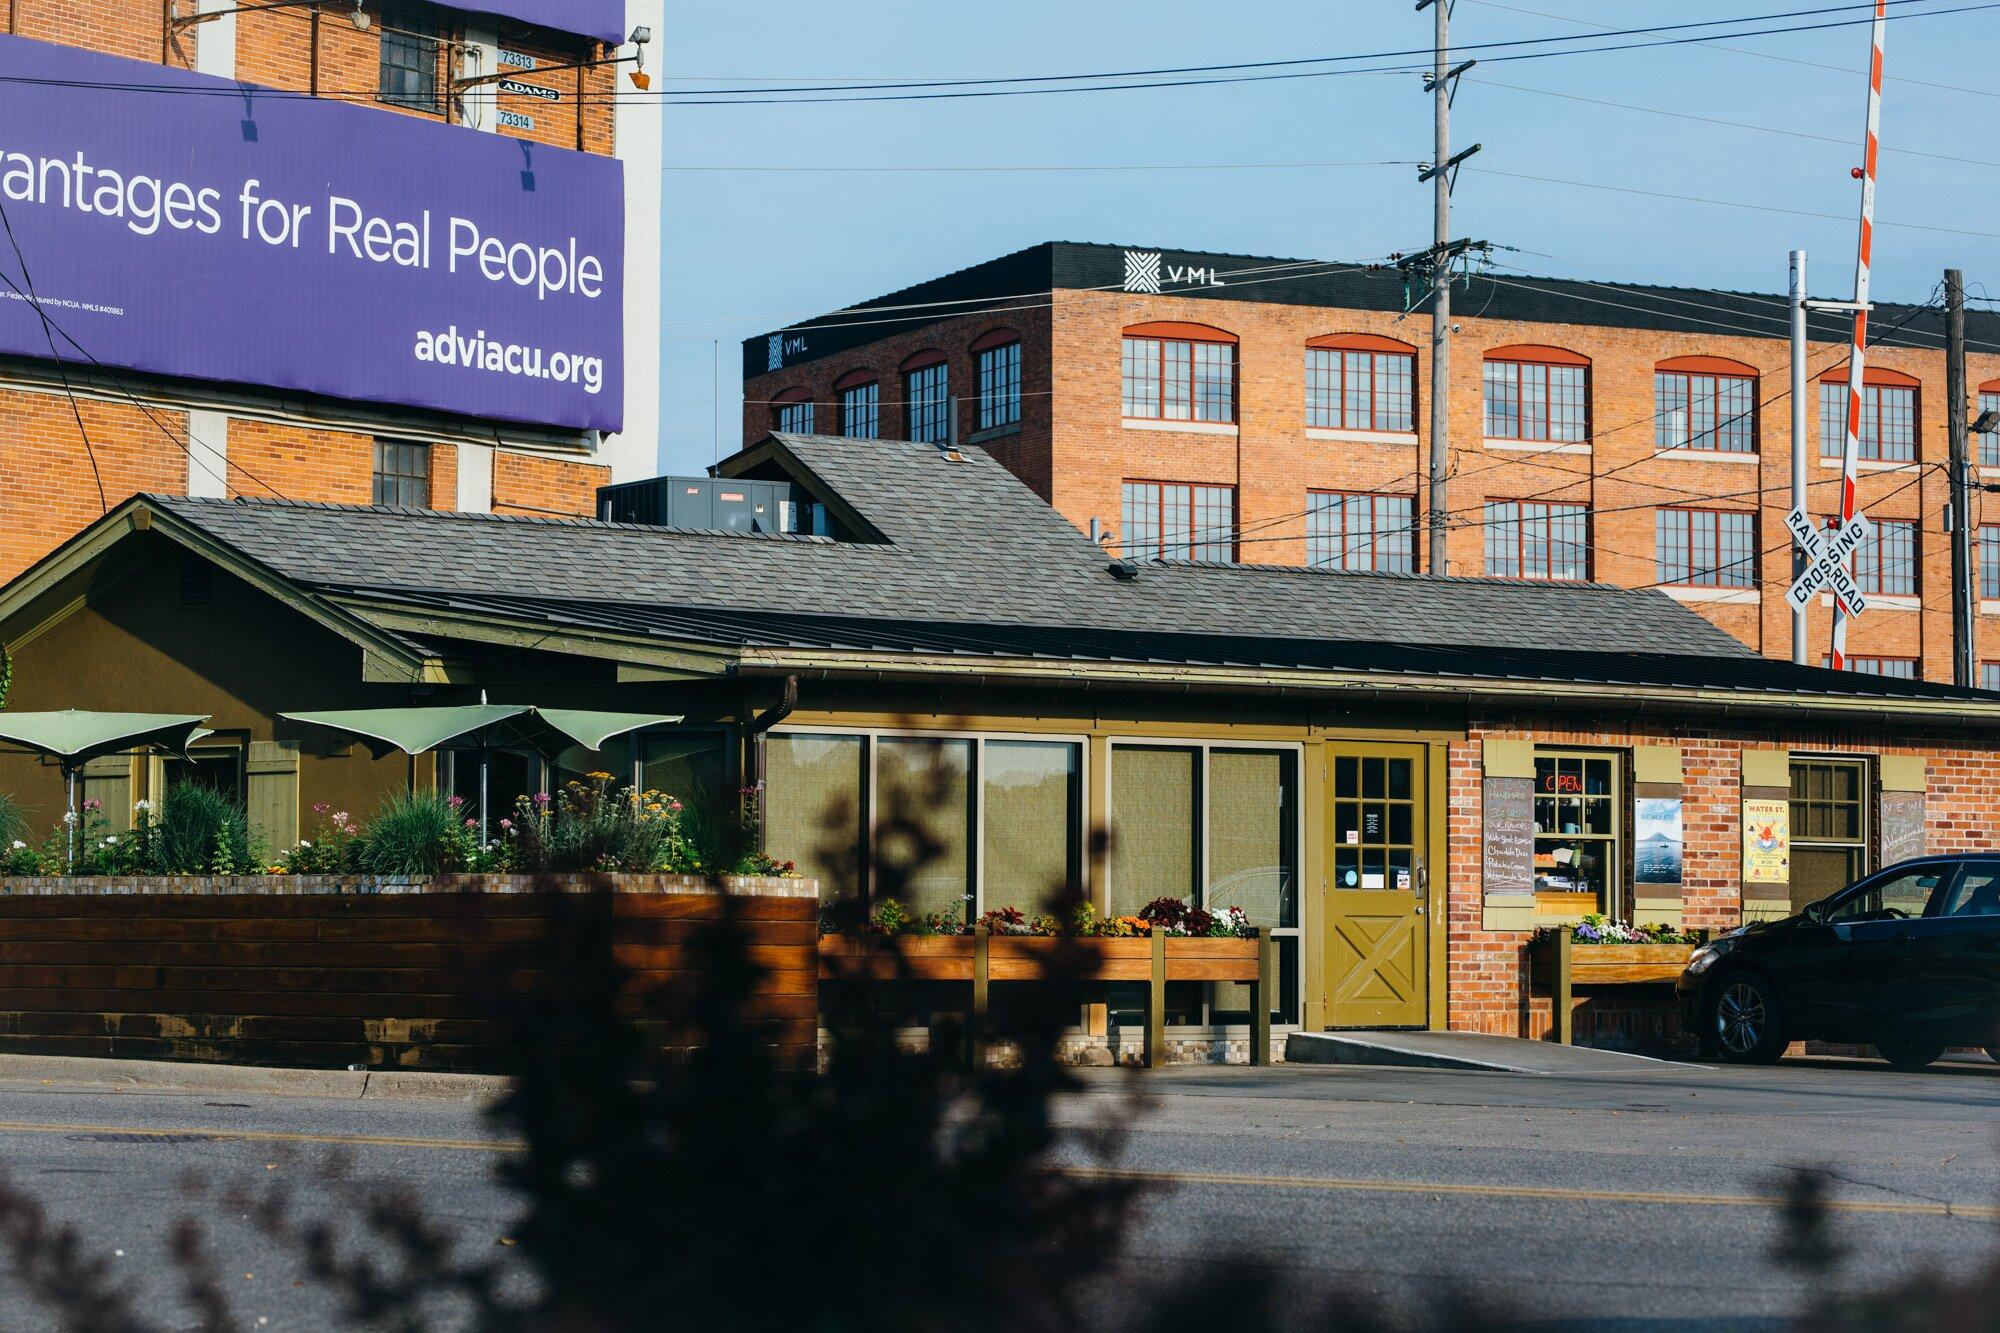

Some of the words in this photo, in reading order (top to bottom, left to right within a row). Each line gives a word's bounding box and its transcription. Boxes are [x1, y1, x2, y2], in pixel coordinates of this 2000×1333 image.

[503, 51, 531, 69] 73313
[503, 82, 556, 99] ADAMS
[500, 112, 530, 128] 73314
[0, 151, 221, 235] antages
[239, 179, 311, 248] for
[329, 196, 429, 268] Real
[450, 217, 603, 300] People
[1167, 265, 1225, 286] VML
[55, 298, 62, 307] by
[82, 303, 99, 311] NMLS
[785, 336, 808, 356] VML
[414, 325, 603, 394] adviacu.org
[1789, 511, 1820, 556] RAIL
[1830, 567, 1865, 615] ROAD
[1794, 523, 1863, 604] CROSSING
[1545, 775, 1583, 792] OPEN
[1748, 805, 1773, 813] WATER
